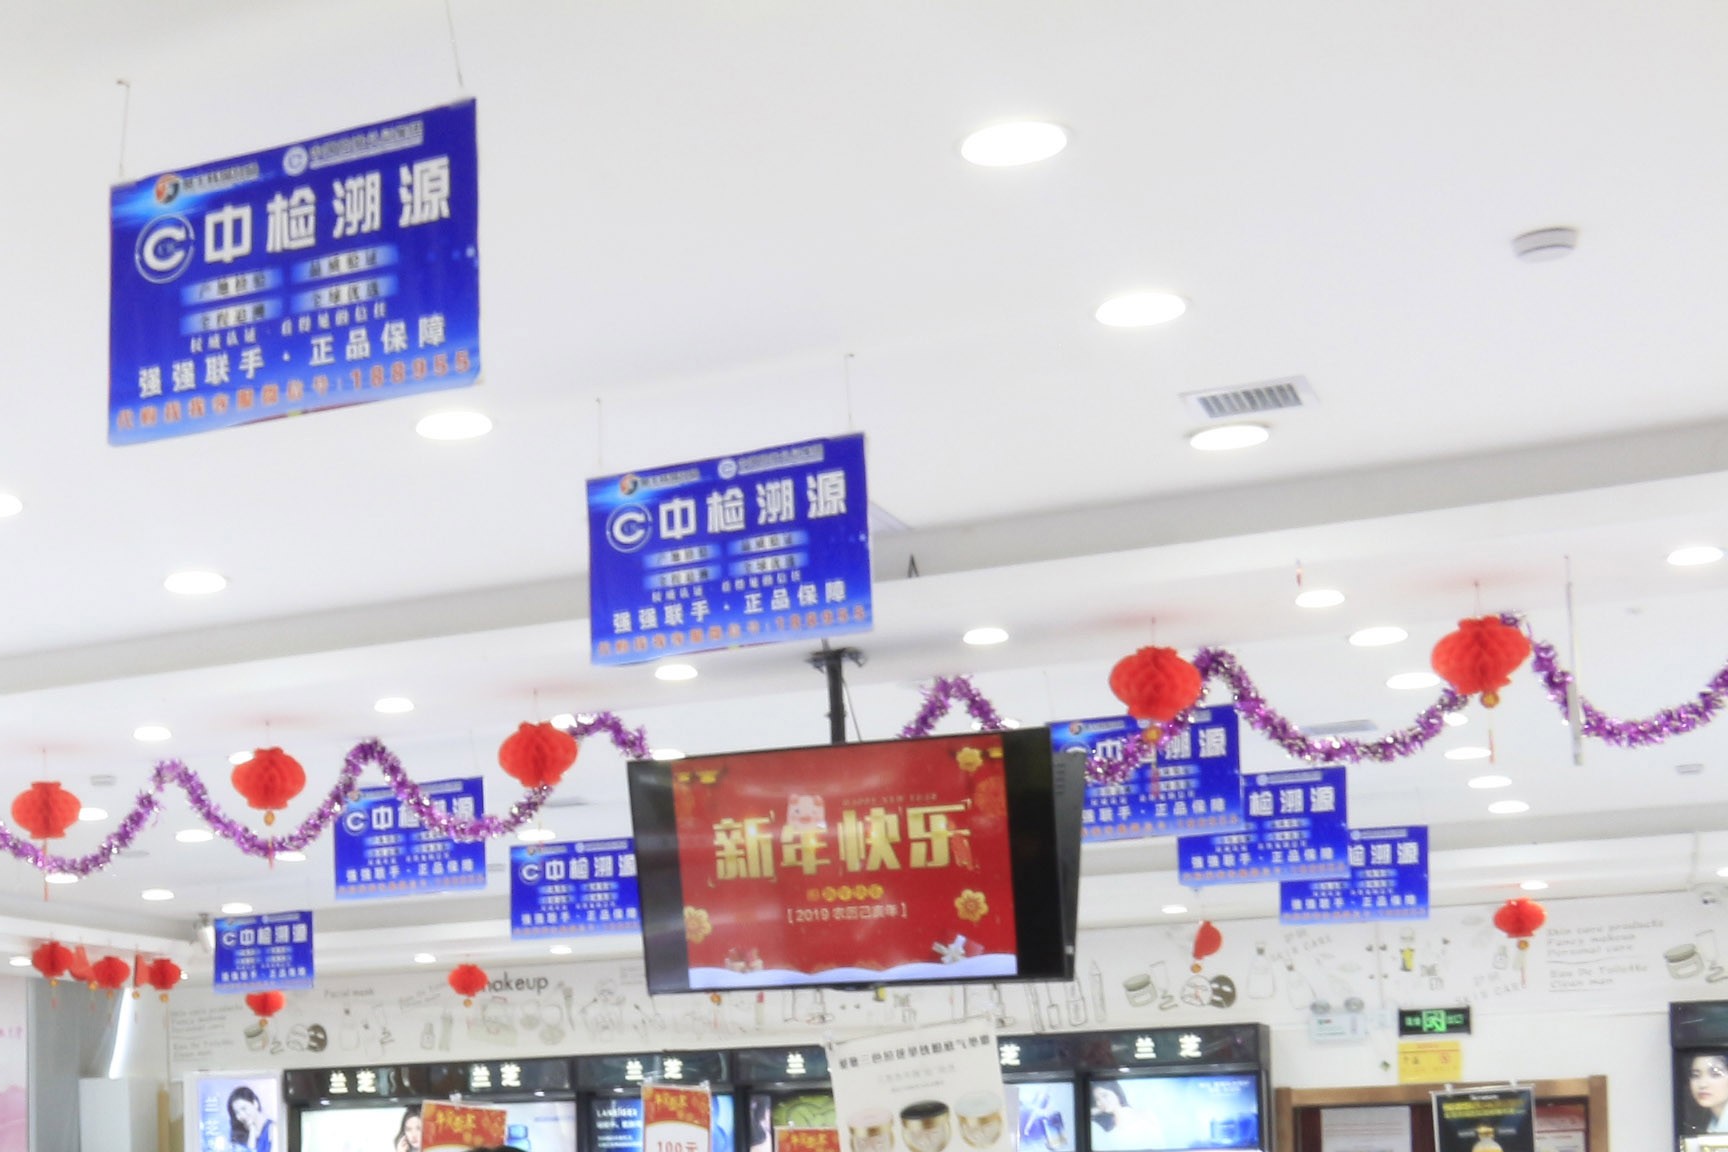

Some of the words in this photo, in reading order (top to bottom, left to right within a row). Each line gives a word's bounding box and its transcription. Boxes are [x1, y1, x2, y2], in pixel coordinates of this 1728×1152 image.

[203, 155, 451, 264] 中检溯源
[659, 470, 847, 540] 中检溯源
[712, 798, 972, 880] 新年快乐
[1135, 1034, 1203, 1060] 兰芝
[328, 1070, 377, 1094] 兰芝
[472, 1063, 522, 1088] 兰芝
